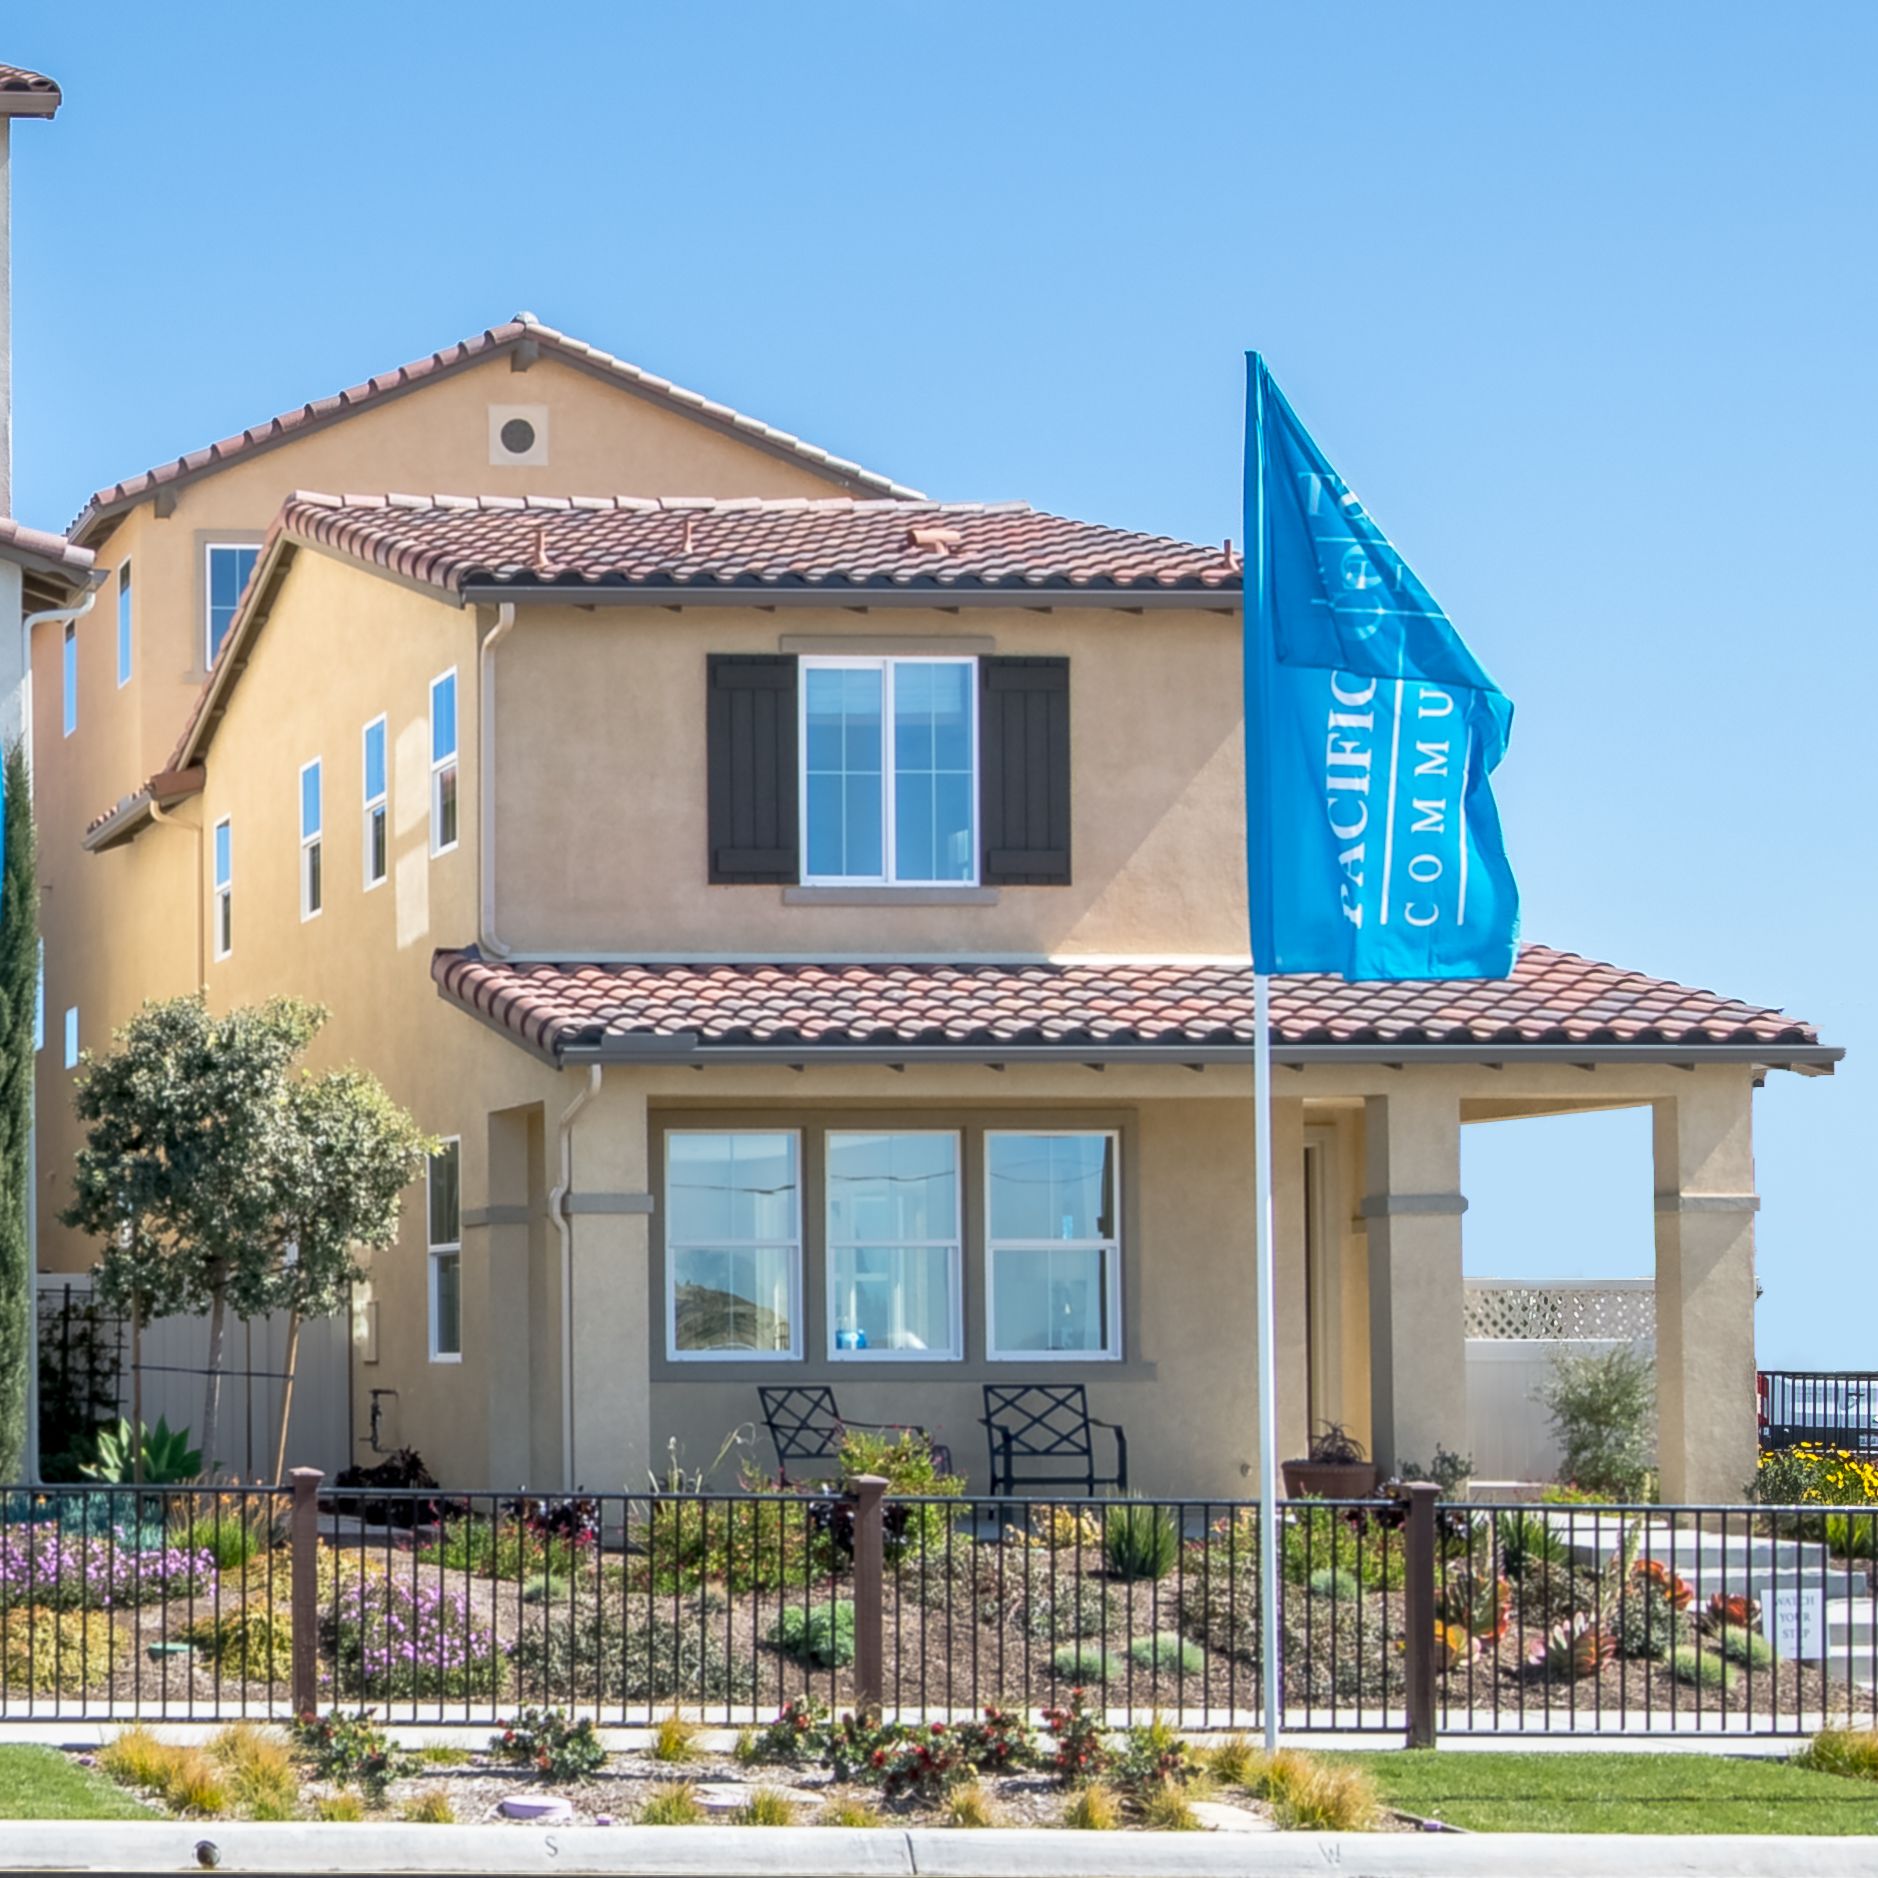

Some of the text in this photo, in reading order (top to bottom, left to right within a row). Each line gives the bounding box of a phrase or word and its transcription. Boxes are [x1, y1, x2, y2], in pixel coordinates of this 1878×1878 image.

[1779, 1612, 1811, 1622] YOR
[1782, 1628, 1811, 1639] STP
[545, 1835, 559, 1858] S
